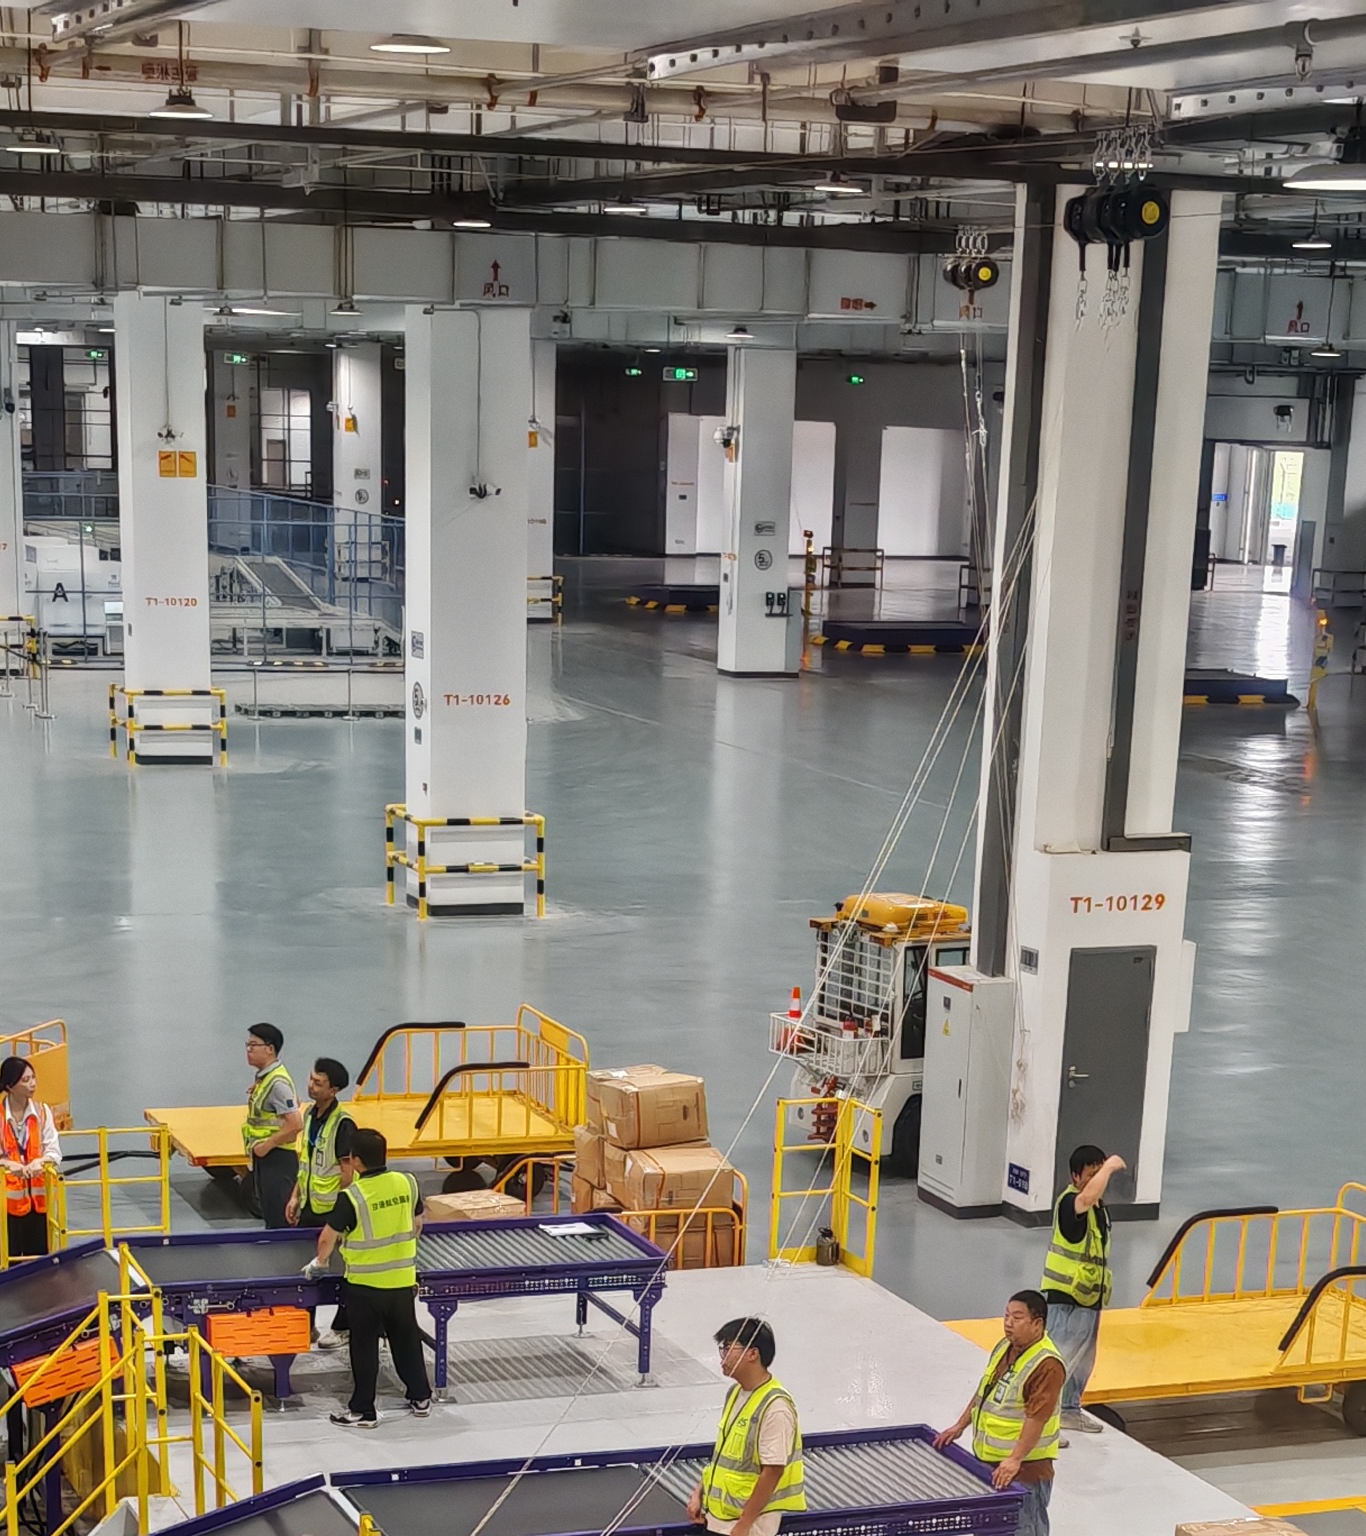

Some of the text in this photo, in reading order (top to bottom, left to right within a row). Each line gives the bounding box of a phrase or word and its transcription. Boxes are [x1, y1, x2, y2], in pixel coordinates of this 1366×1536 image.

[52, 582, 69, 602] A
[145, 597, 198, 607] T1-10120
[443, 694, 511, 706] T1-10126
[1070, 893, 1166, 914] T1-10129
